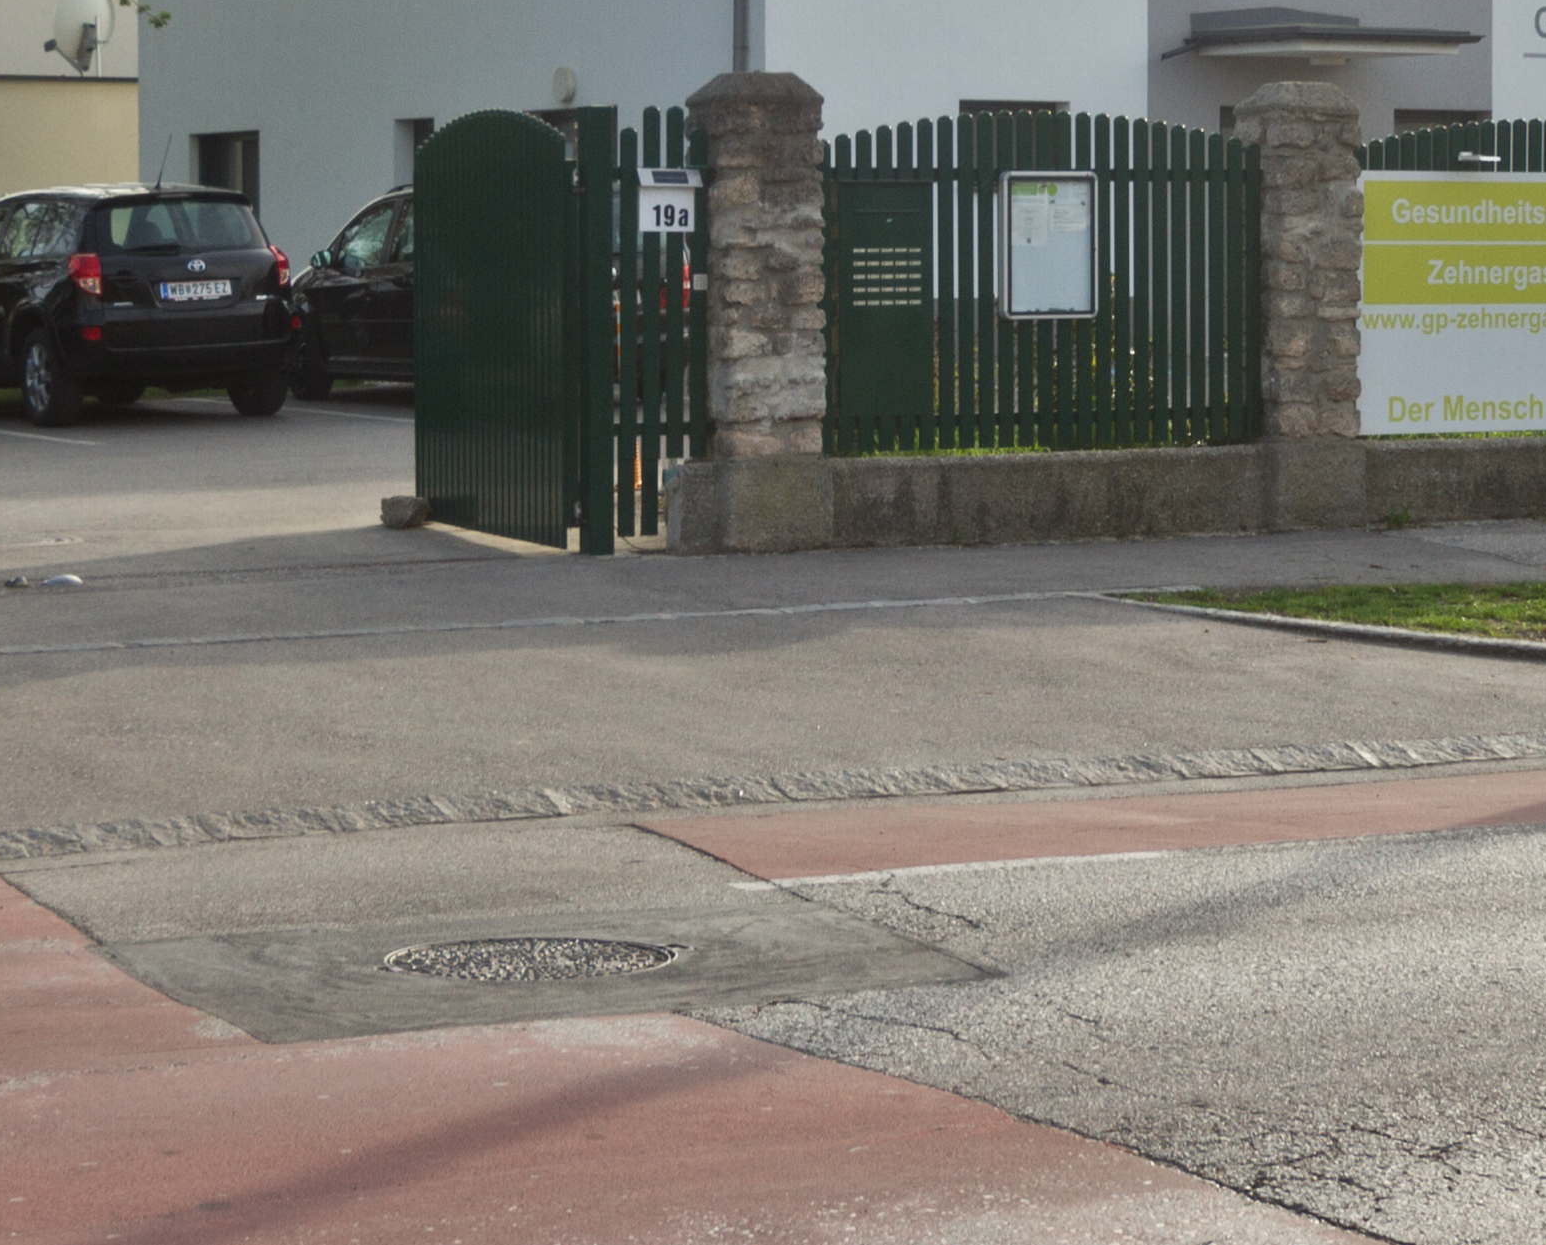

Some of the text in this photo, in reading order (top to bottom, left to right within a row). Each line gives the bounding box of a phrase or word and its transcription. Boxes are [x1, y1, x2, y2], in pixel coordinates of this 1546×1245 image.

[170, 281, 228, 295] WB 275 EZ
[1388, 395, 1434, 423] Der
[1442, 393, 1544, 421] Mensch
